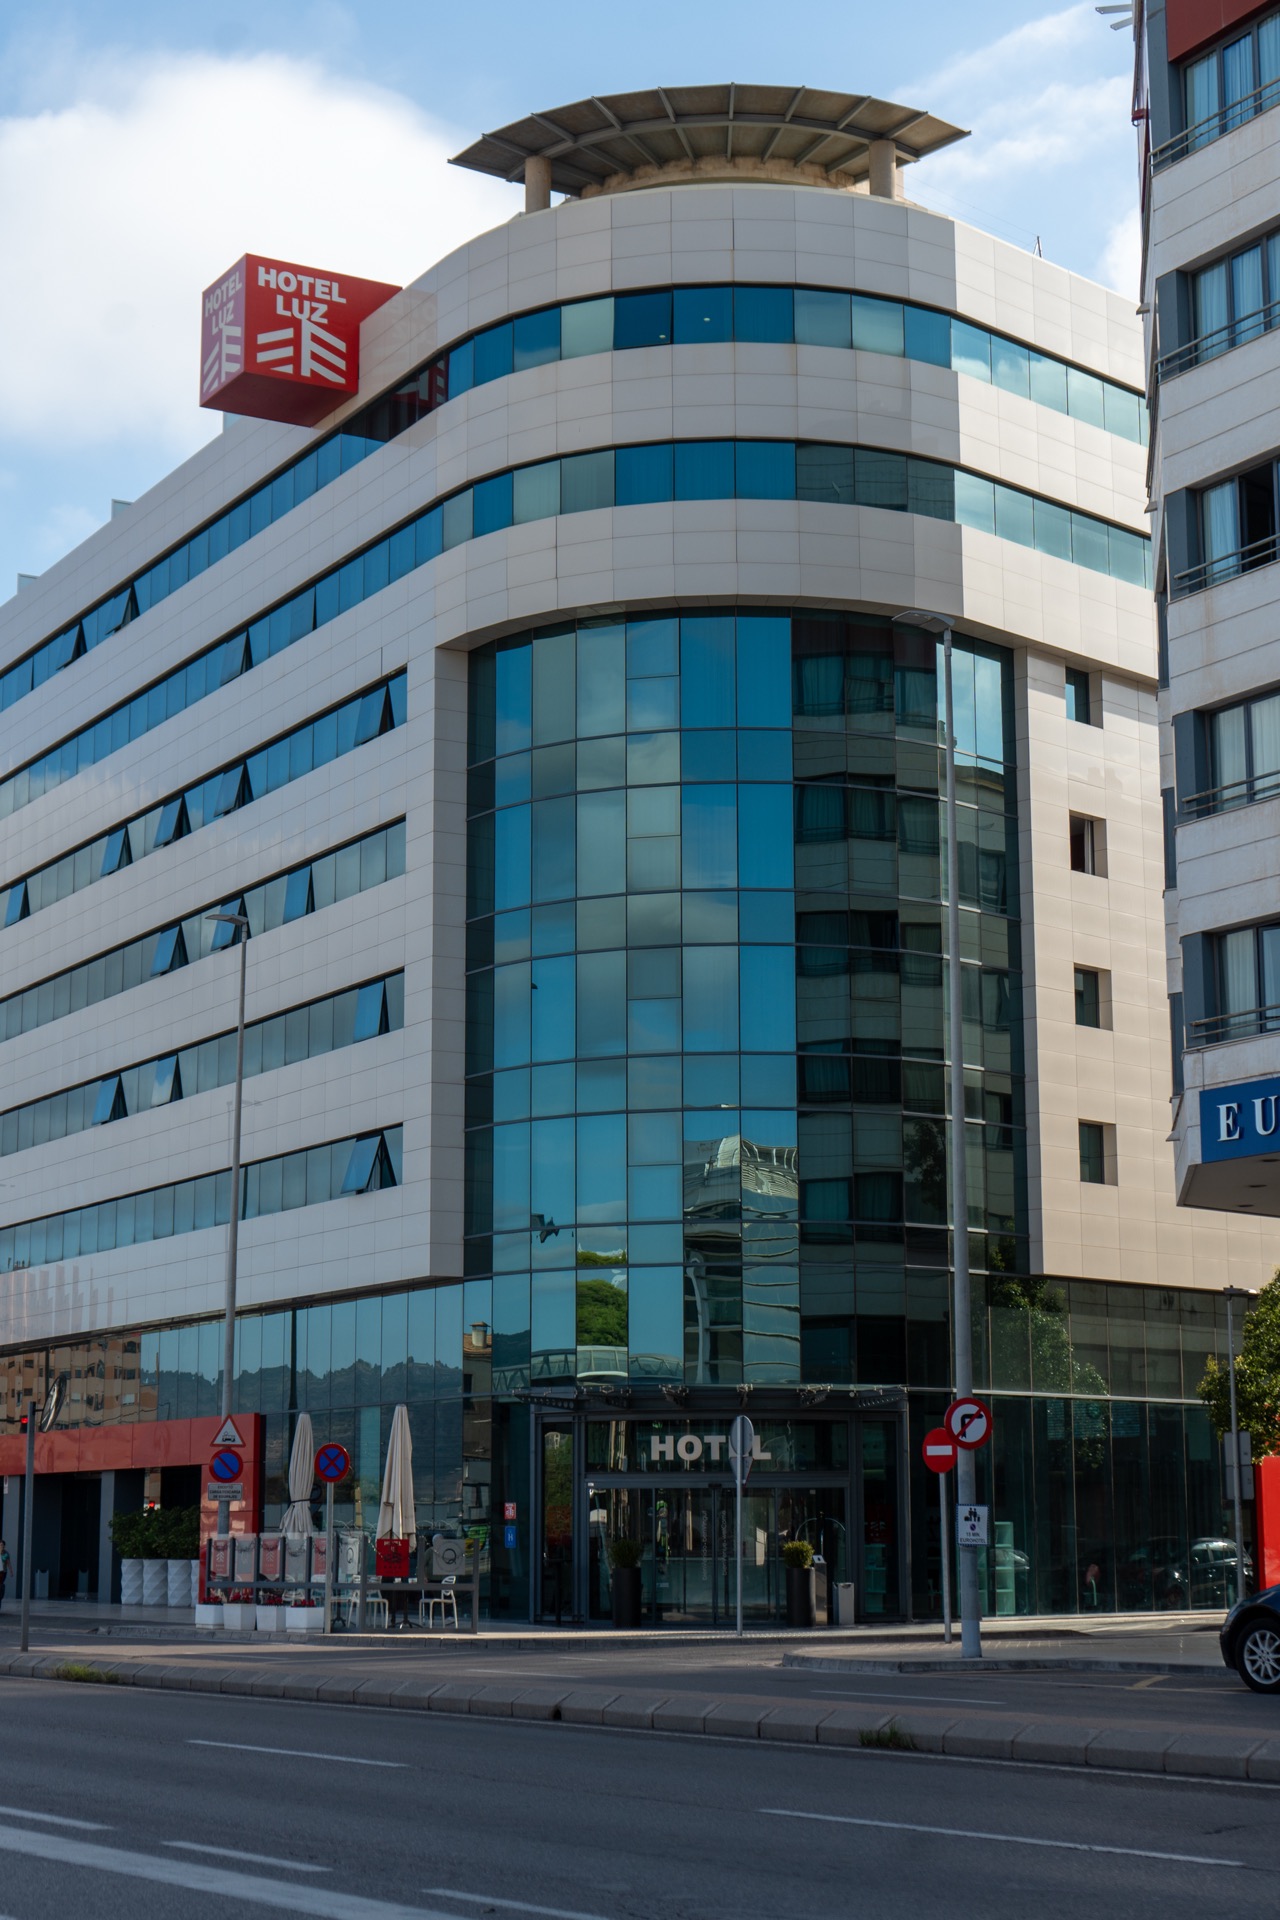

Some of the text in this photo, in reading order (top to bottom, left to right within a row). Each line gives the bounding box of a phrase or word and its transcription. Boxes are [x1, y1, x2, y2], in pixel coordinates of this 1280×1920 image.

[205, 271, 242, 318] HOTEL
[258, 266, 346, 304] HOTEL
[212, 300, 234, 336] LUZ
[276, 294, 328, 324] LUZ
[1216, 1095, 1280, 1142] EU
